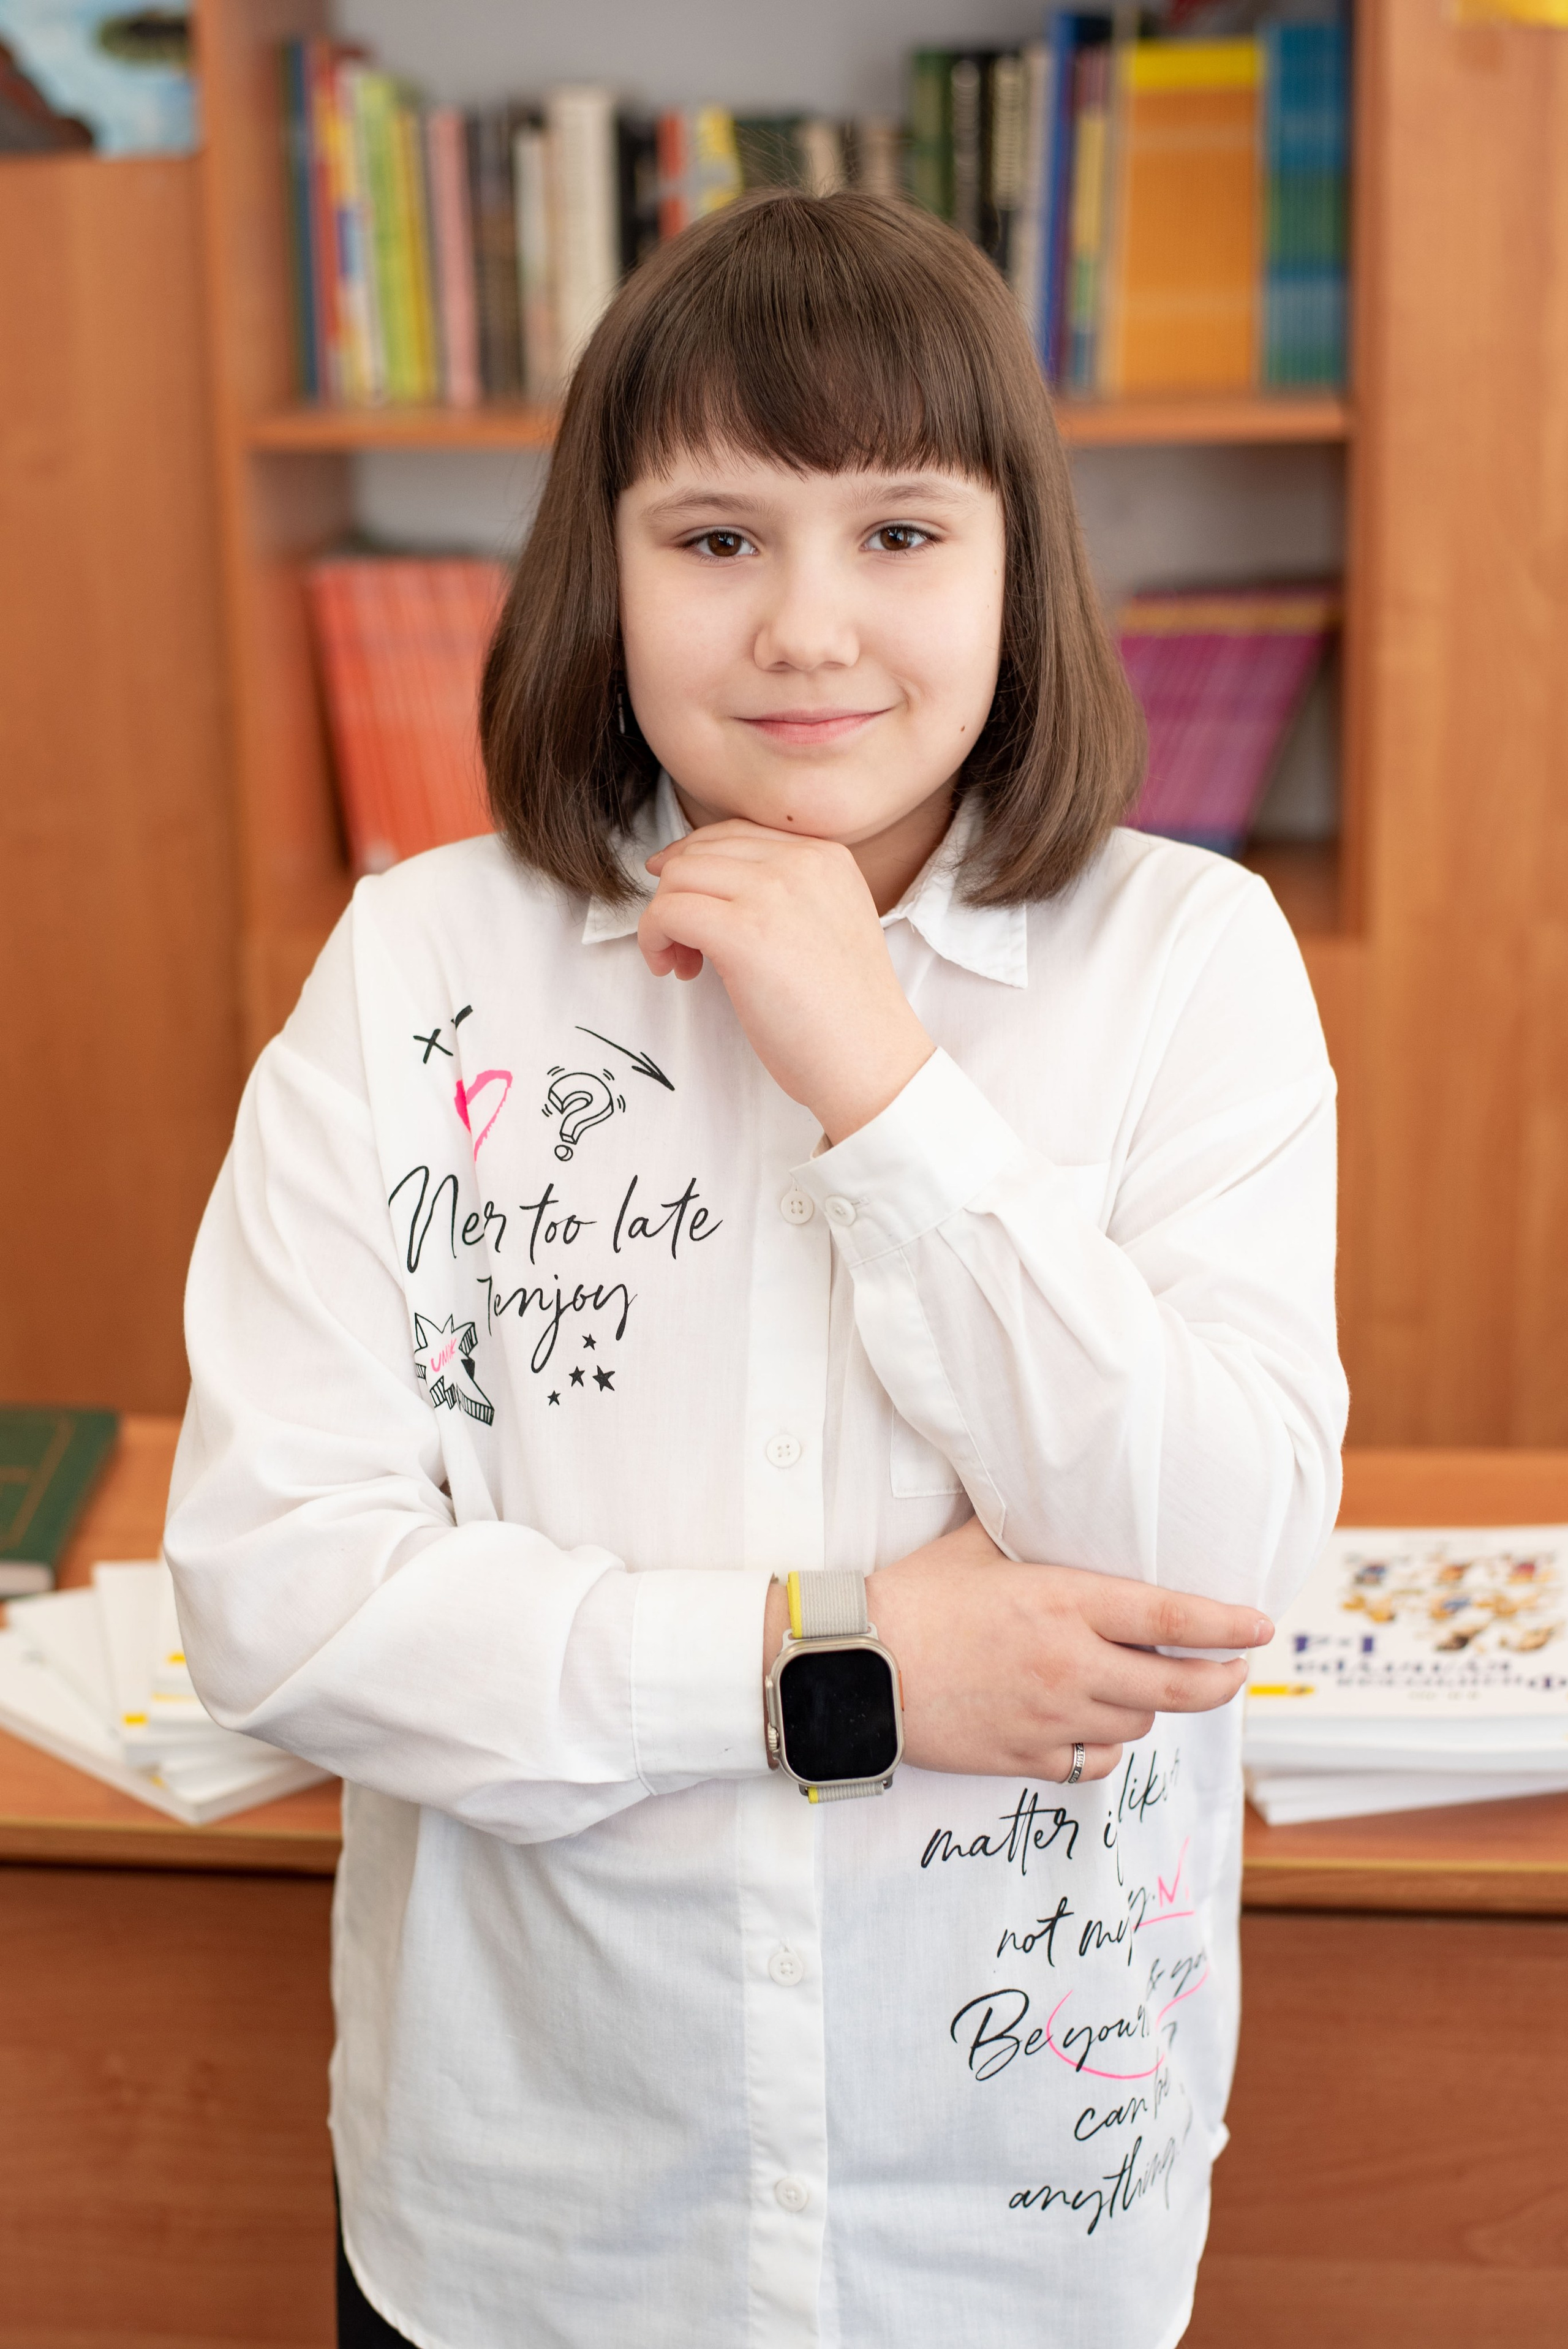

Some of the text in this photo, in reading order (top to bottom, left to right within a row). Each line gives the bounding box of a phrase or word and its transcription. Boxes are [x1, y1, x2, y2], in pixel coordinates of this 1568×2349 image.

[519, 1183, 597, 1265] too
[613, 1174, 723, 1260] late
[921, 1787, 1079, 1876] matter
[997, 1896, 1074, 1968] not
[950, 1988, 1053, 2082] Be
[1074, 2097, 1148, 2142] can
